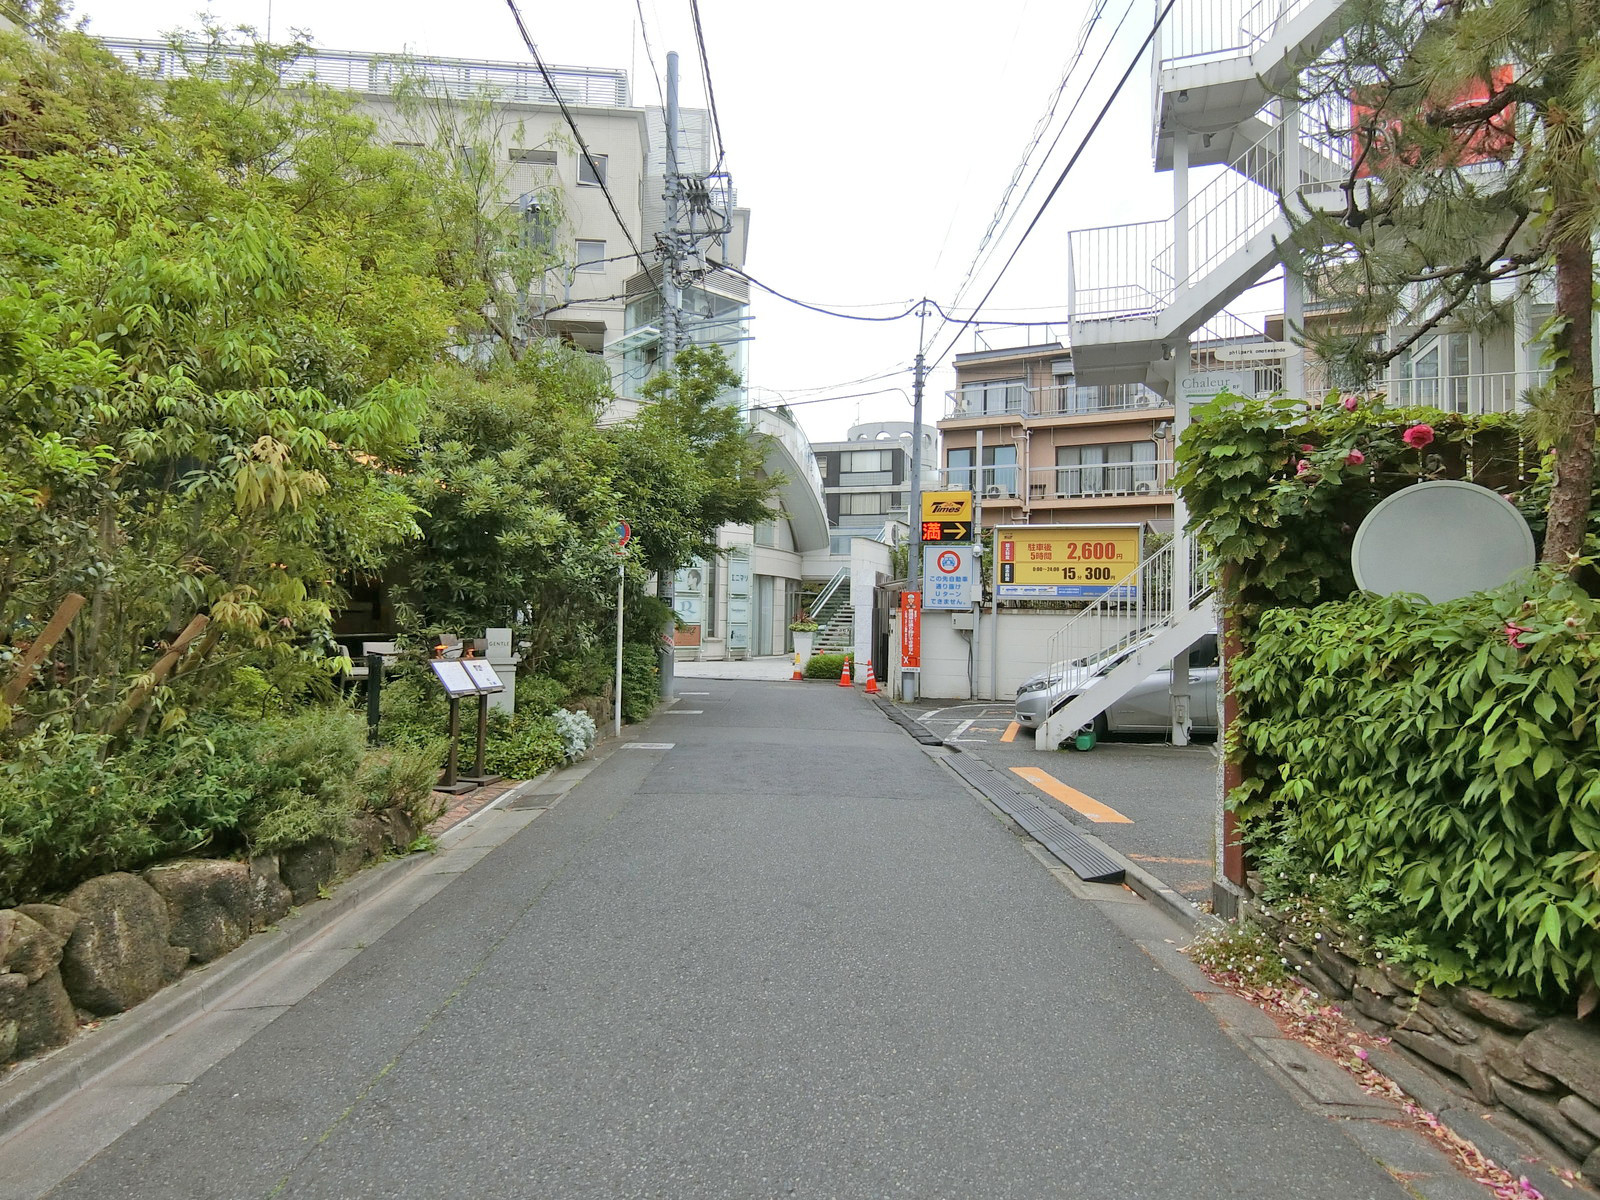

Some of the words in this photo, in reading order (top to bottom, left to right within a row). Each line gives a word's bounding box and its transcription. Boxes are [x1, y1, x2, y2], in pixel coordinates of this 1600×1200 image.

[1182, 377, 1230, 389] Chaleur
[930, 501, 965, 514] Times
[922, 522, 941, 541] 満
[1027, 543, 1052, 552] 駐車後
[1030, 552, 1052, 560] 5時間
